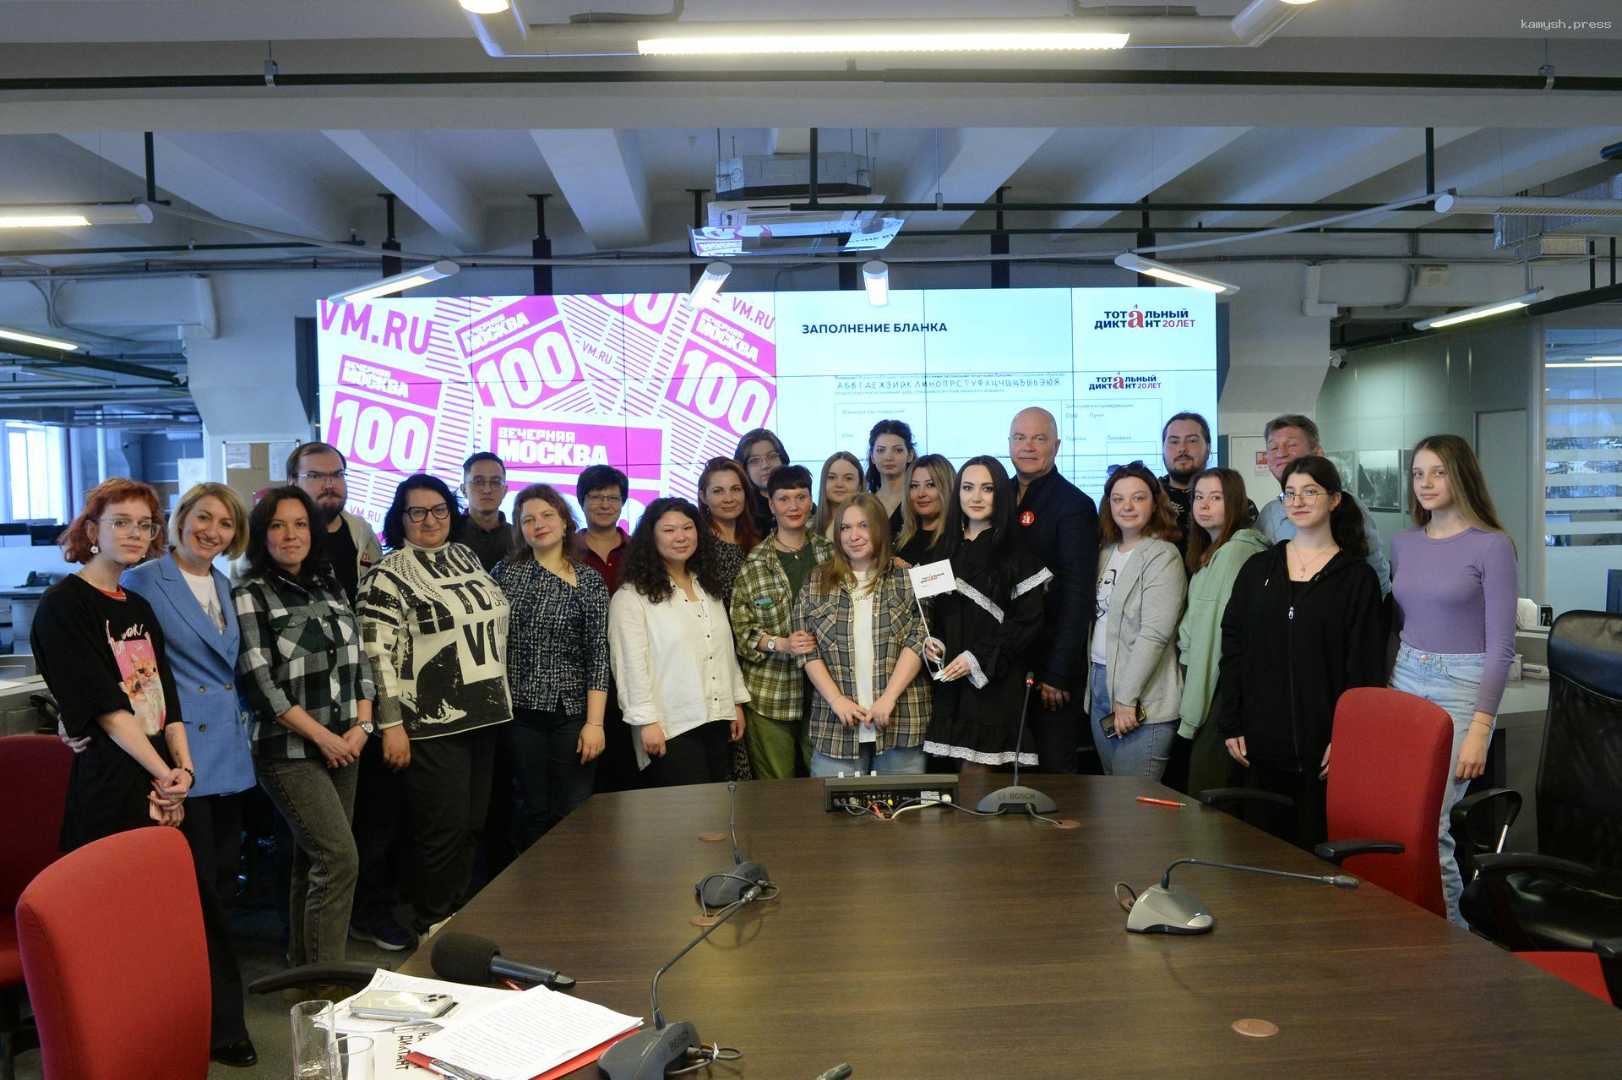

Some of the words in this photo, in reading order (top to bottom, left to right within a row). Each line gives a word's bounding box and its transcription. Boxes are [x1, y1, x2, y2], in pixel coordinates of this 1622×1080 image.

[320, 298, 433, 355] VM.RU
[732, 297, 775, 331] VM.RU
[802, 323, 891, 335] ЗАПОЛНЕНИЕ
[893, 321, 948, 334] БЛАНКА
[476, 330, 577, 408] 100
[582, 340, 614, 366] VM.RU
[674, 349, 771, 437] 100
[334, 398, 430, 475] 100
[498, 438, 609, 466] МОСКВА
[349, 504, 382, 524] VM.RU
